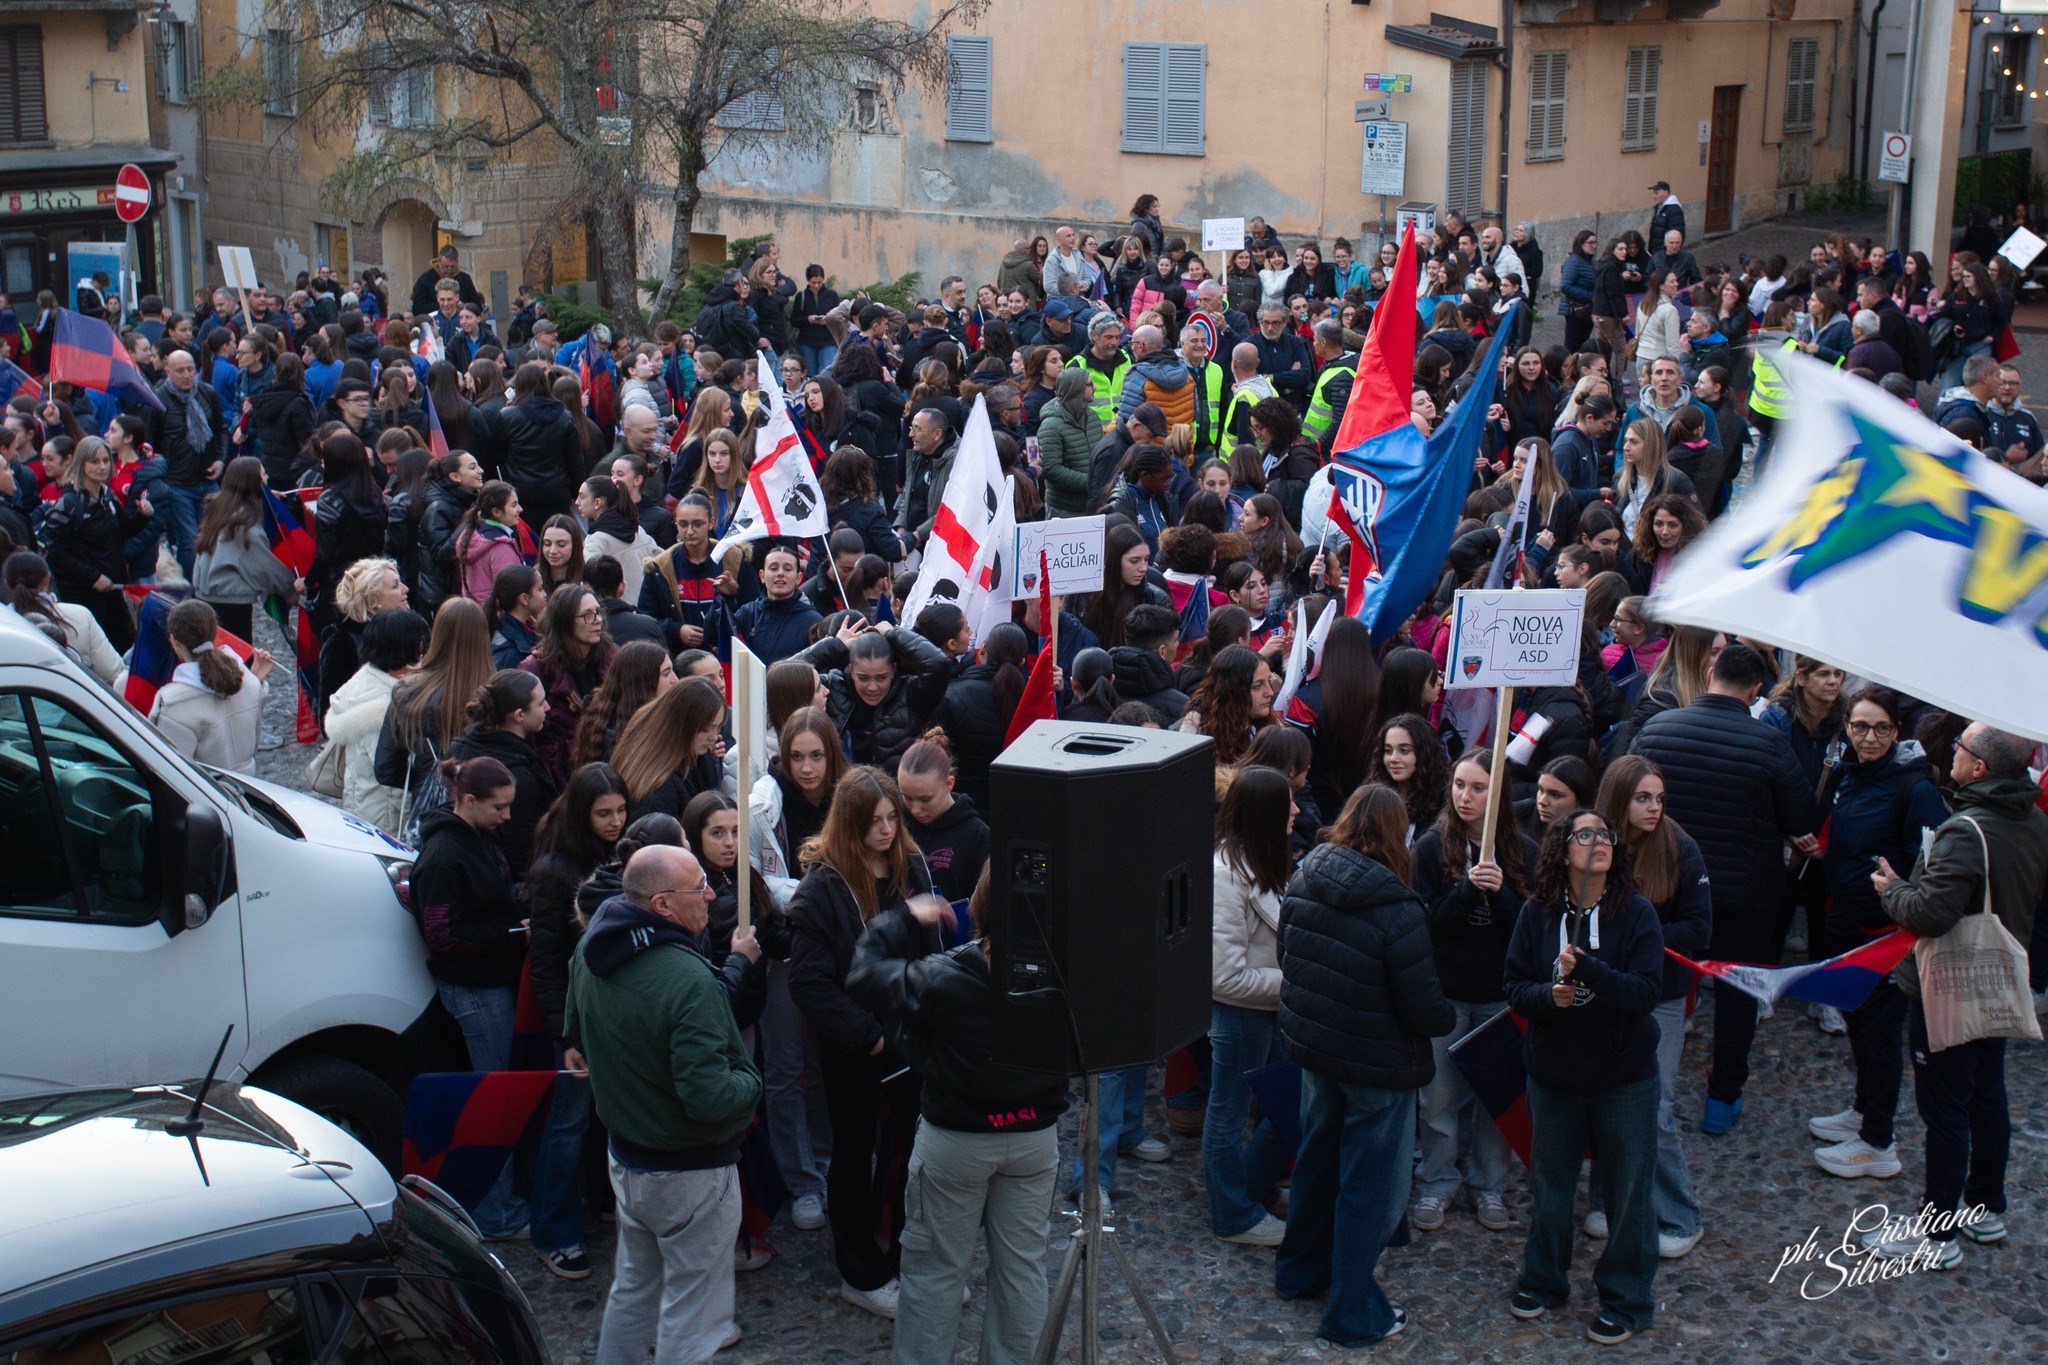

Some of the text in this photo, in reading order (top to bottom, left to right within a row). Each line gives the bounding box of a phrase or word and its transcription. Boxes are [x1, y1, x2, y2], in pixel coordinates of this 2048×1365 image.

[29, 190, 82, 212] Red
[1061, 542, 1086, 556] CUS
[1512, 616, 1564, 632] NOVA
[1509, 632, 1563, 645] VOLLEY
[1518, 650, 1548, 663] ASD
[1988, 1005, 2014, 1014] British
